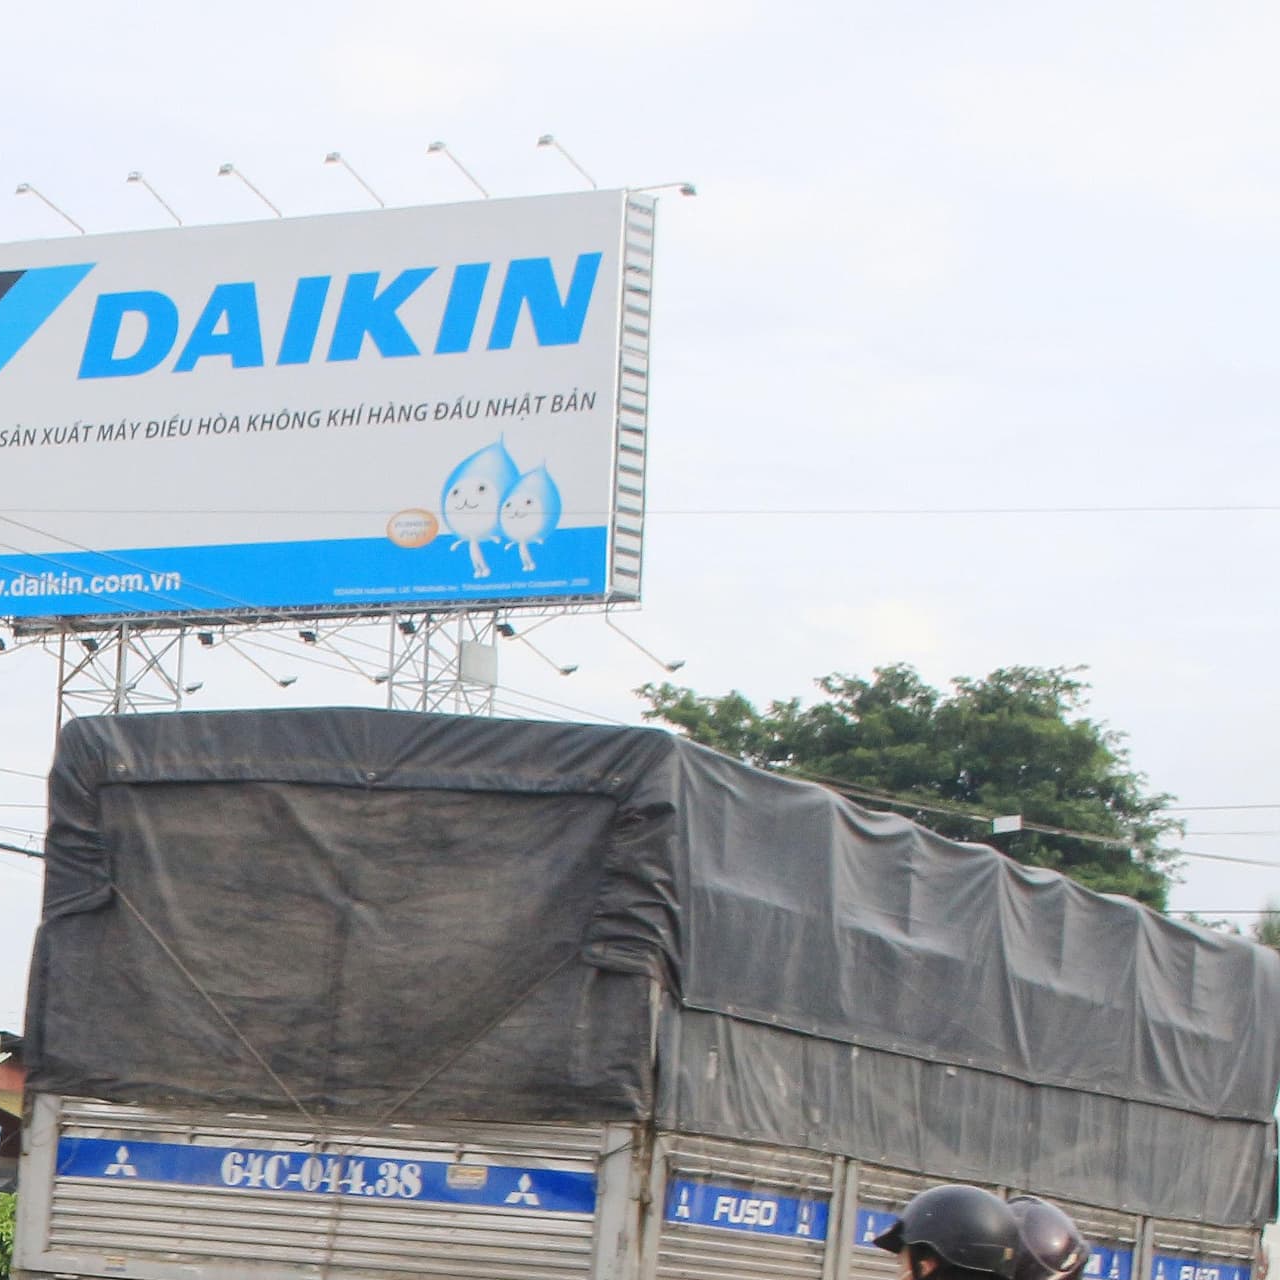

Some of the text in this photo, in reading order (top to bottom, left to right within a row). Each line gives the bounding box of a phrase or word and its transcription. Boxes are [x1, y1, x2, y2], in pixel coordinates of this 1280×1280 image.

[77, 252, 603, 380] DAIKIN
[41, 419, 93, 445] XUẤT
[96, 418, 141, 442] MÁY
[197, 412, 240, 435] HÒA
[247, 408, 321, 432] KHÔNG
[327, 402, 364, 427] KHÍ
[367, 401, 428, 425] HÀNG
[485, 392, 546, 421] NHẬT
[550, 387, 596, 414] BẢN
[221, 1151, 423, 1198] 64C-044.38
[713, 1196, 778, 1227] FUSO
